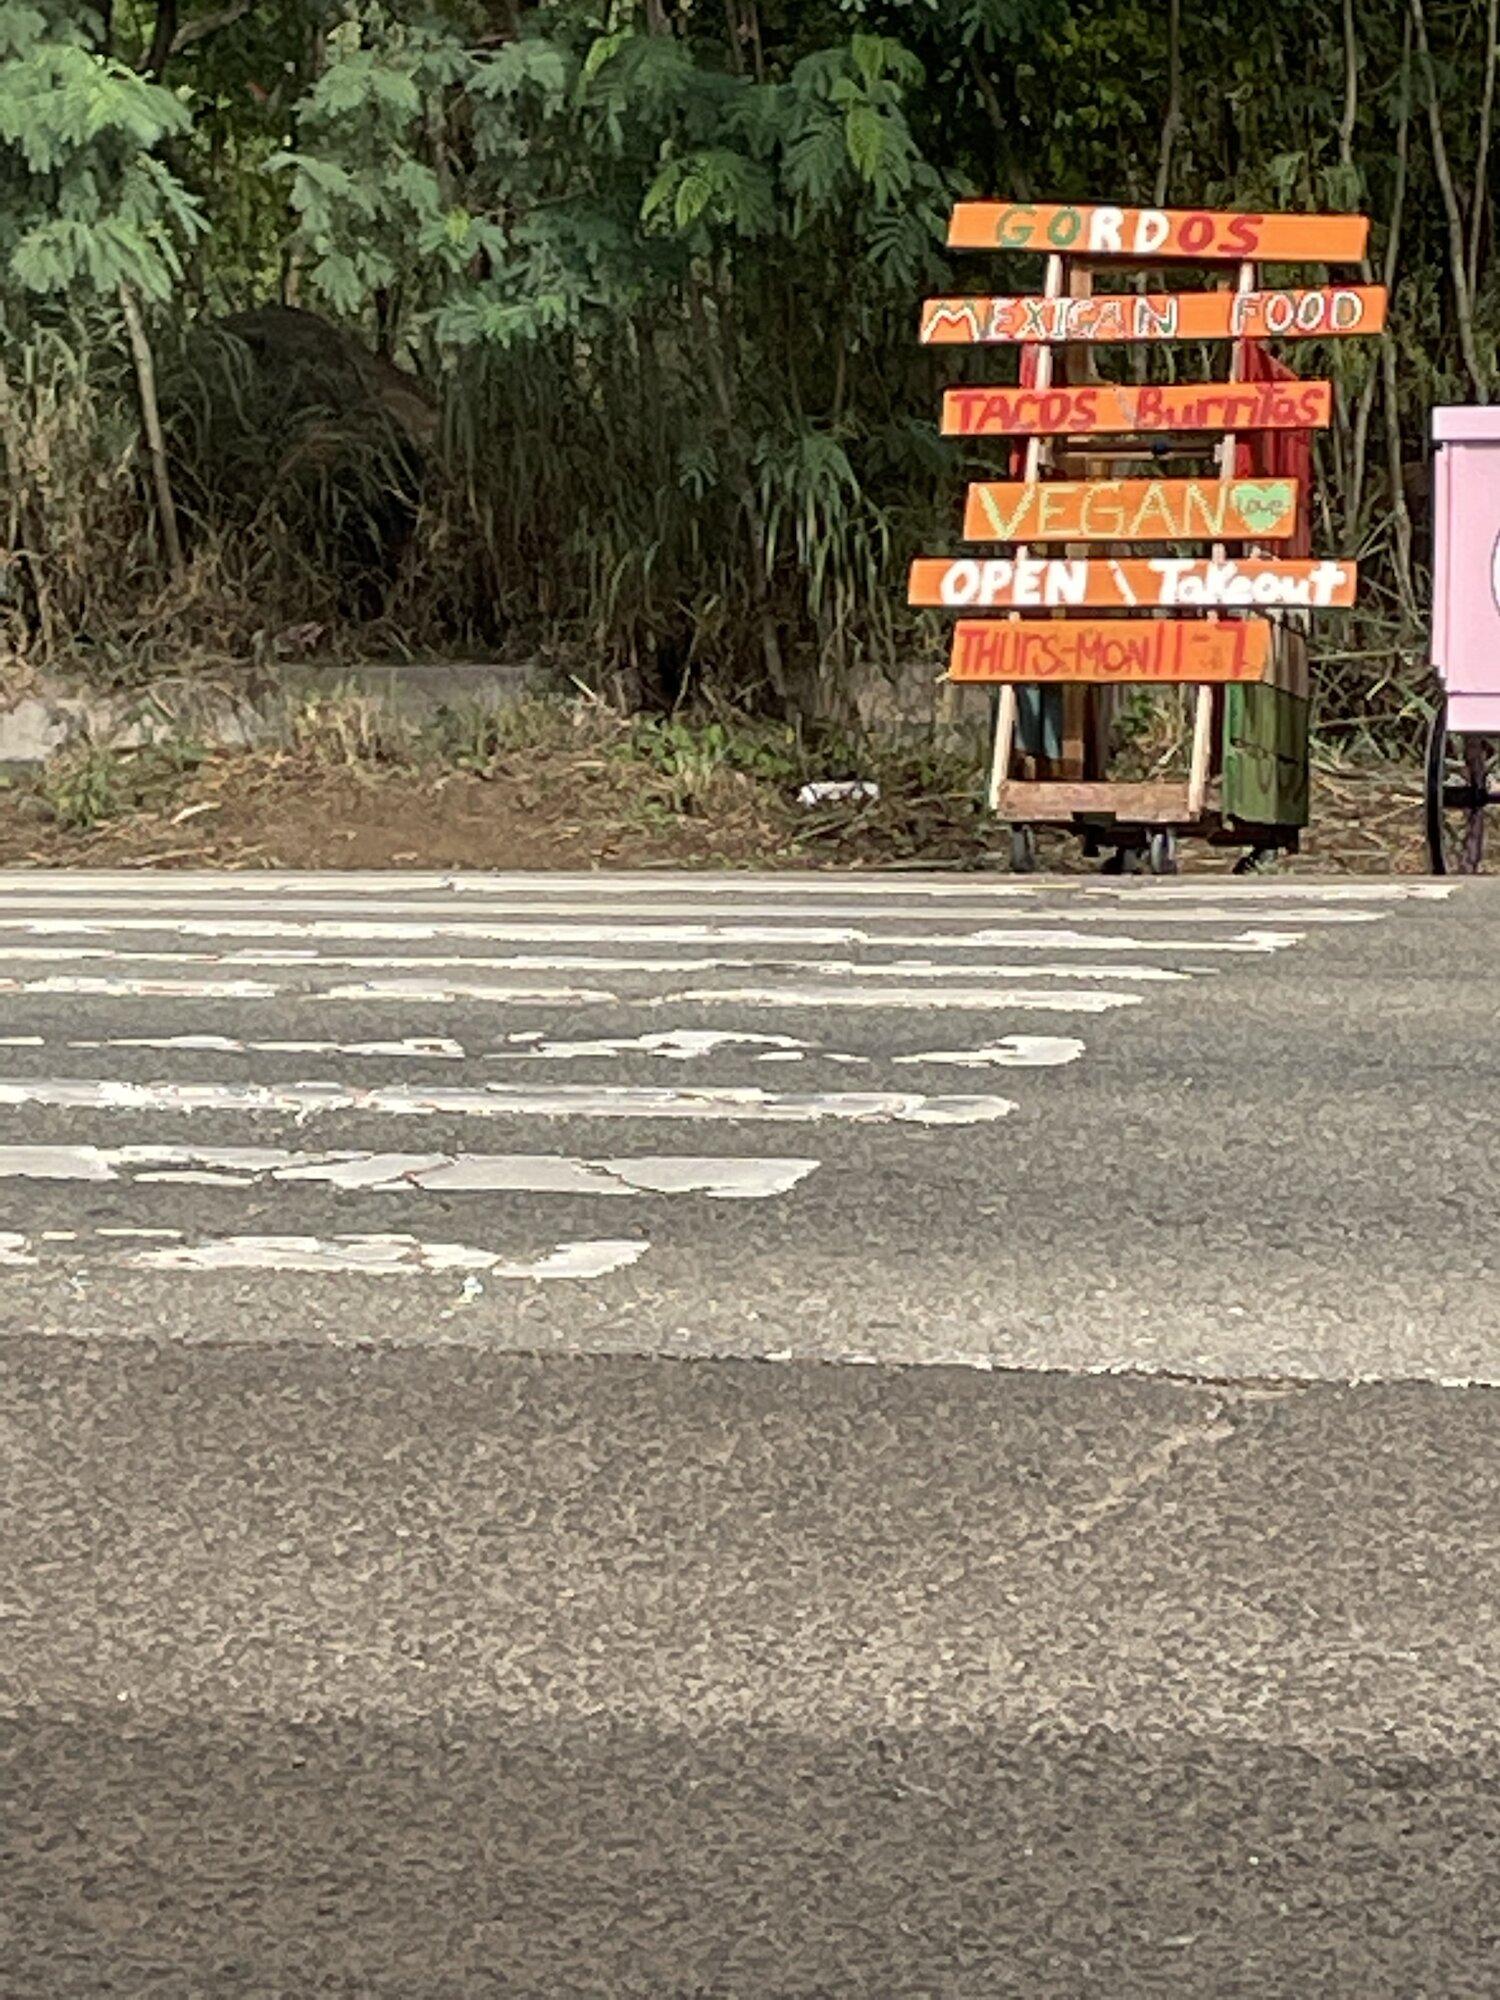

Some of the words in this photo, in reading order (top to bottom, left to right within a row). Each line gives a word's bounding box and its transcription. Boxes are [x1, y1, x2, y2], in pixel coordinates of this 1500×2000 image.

[996, 205, 1264, 254] GORDOS
[921, 298, 1179, 342] MEXICAN
[1231, 291, 1363, 337] FOOD
[951, 391, 1097, 432] TACOS
[979, 483, 1226, 540] VEGAN
[940, 559, 1089, 606] OPEN
[1149, 558, 1347, 606] Takeout
